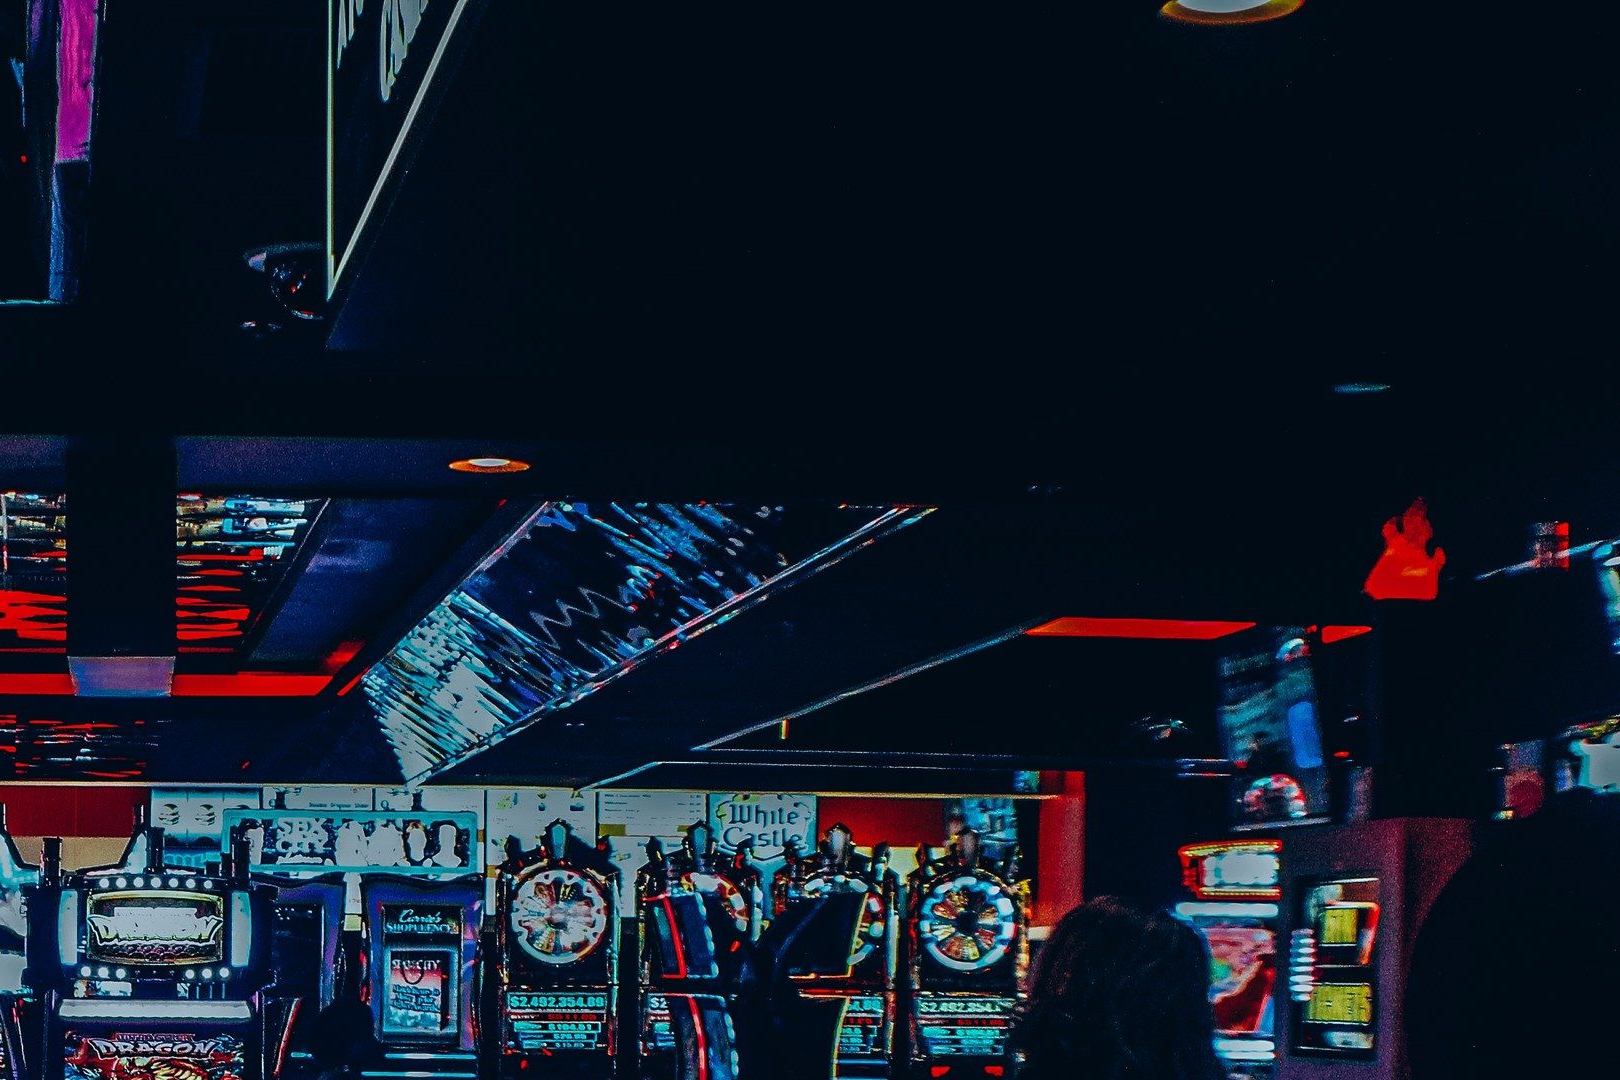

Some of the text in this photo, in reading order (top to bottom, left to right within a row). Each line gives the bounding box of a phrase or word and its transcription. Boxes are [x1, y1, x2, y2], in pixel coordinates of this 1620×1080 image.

[729, 803, 799, 828] White
[723, 827, 805, 848] Castle
[92, 1040, 217, 1056] DRAGON
